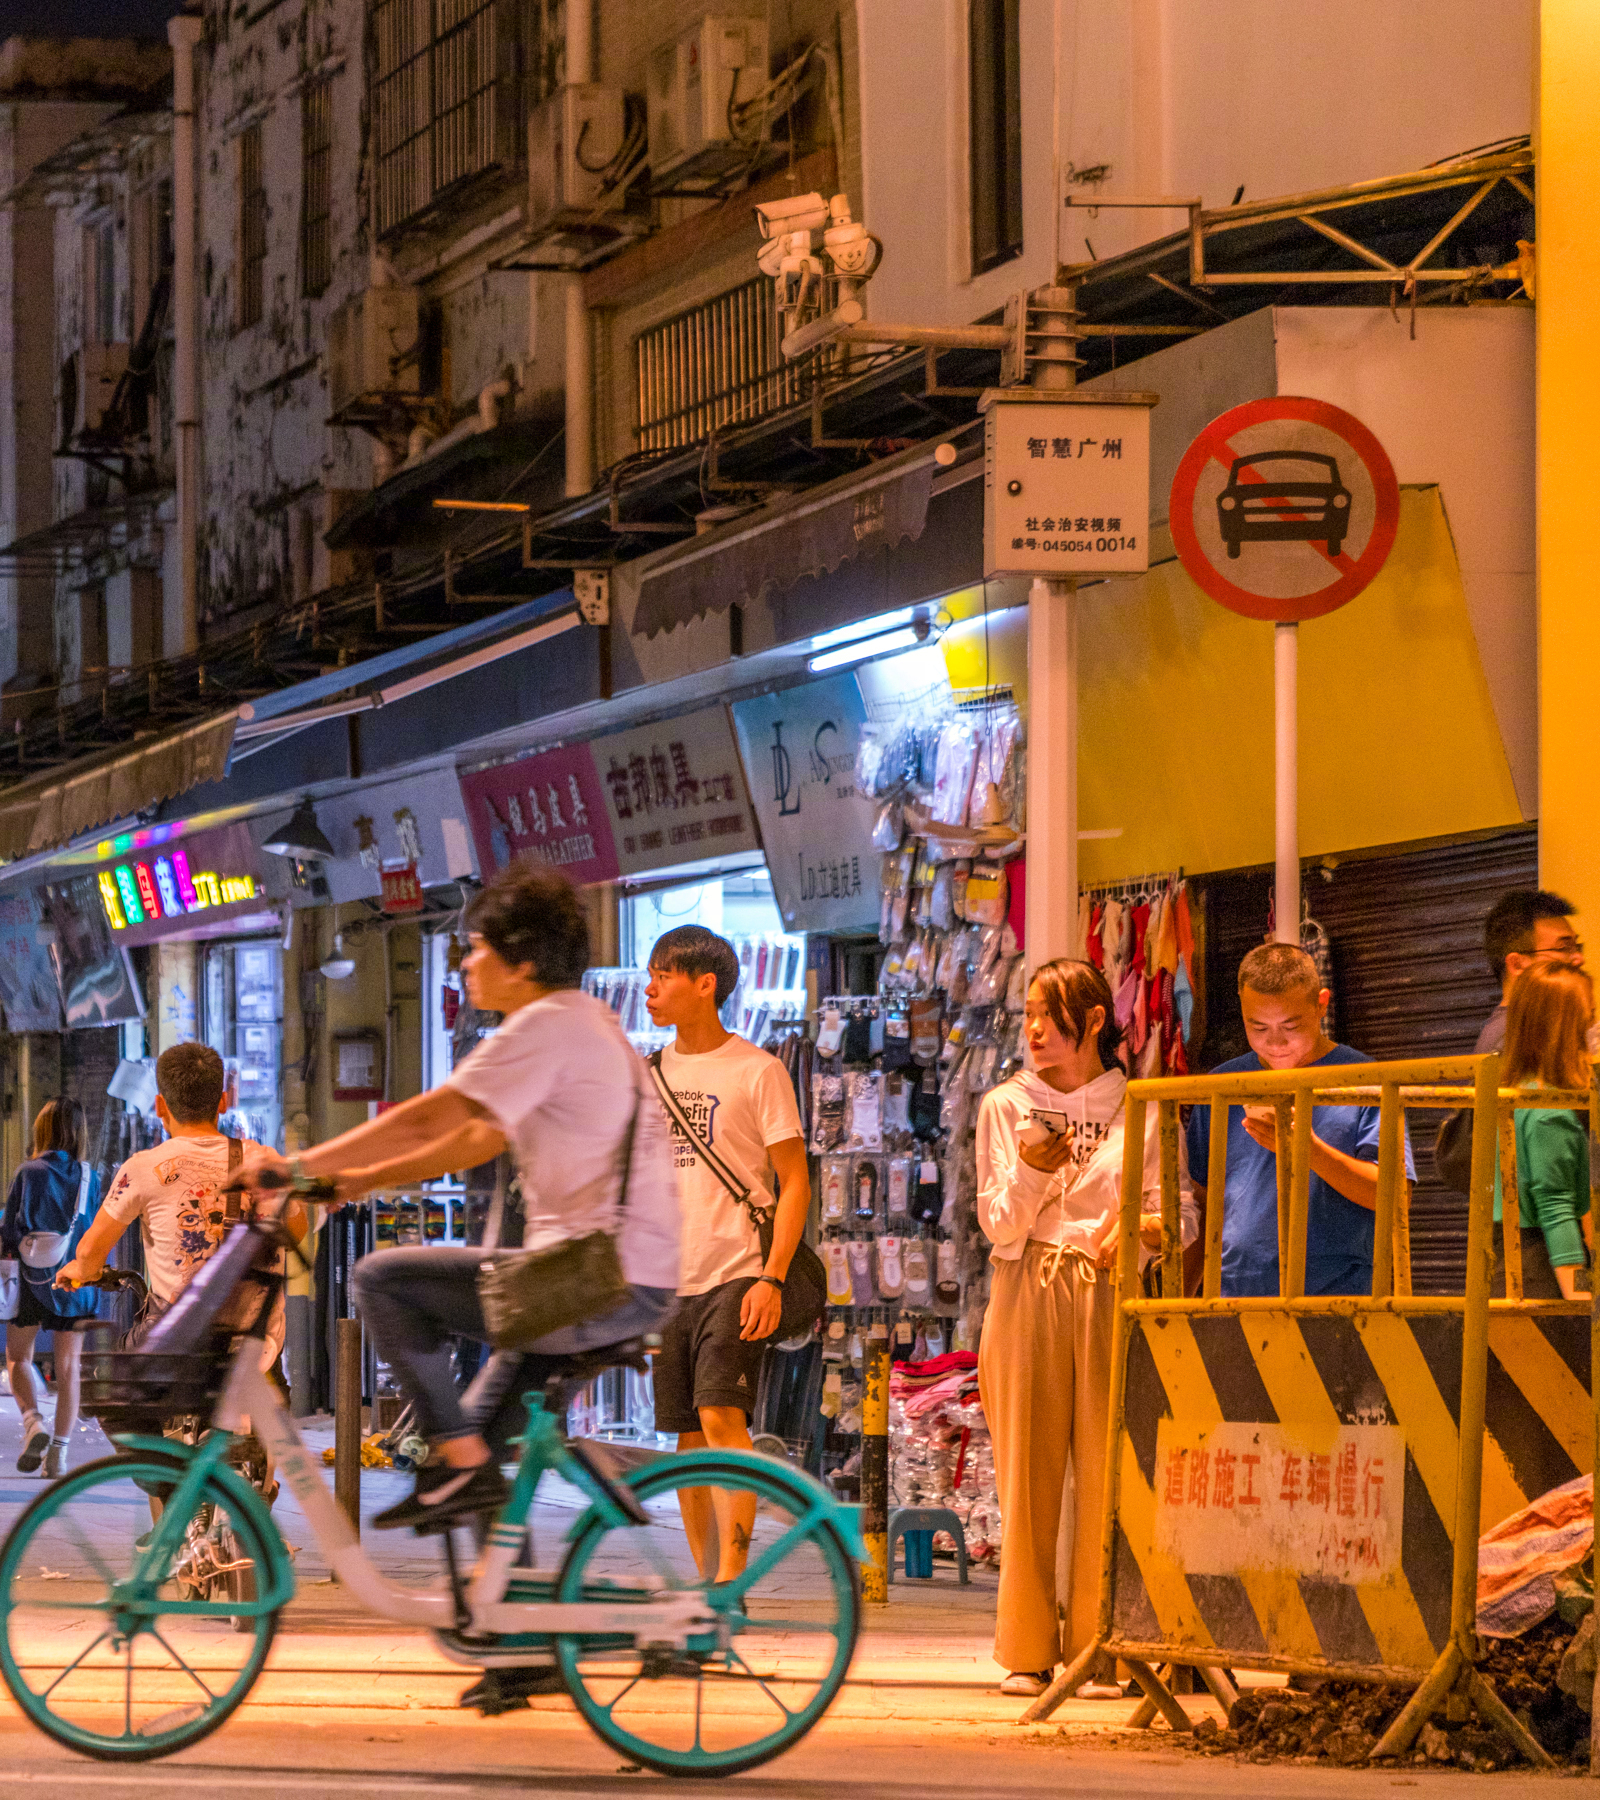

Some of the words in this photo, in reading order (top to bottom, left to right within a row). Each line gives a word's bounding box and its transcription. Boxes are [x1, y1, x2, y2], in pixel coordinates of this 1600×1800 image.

[1026, 436, 1122, 460] 智慧广州
[1025, 517, 1122, 533] 社会治安视频
[672, 1089, 706, 1101] eebok
[673, 1157, 696, 1168] 2019
[1165, 1446, 1262, 1509] 道路施工
[1279, 1442, 1385, 1519] 车辆慢行
